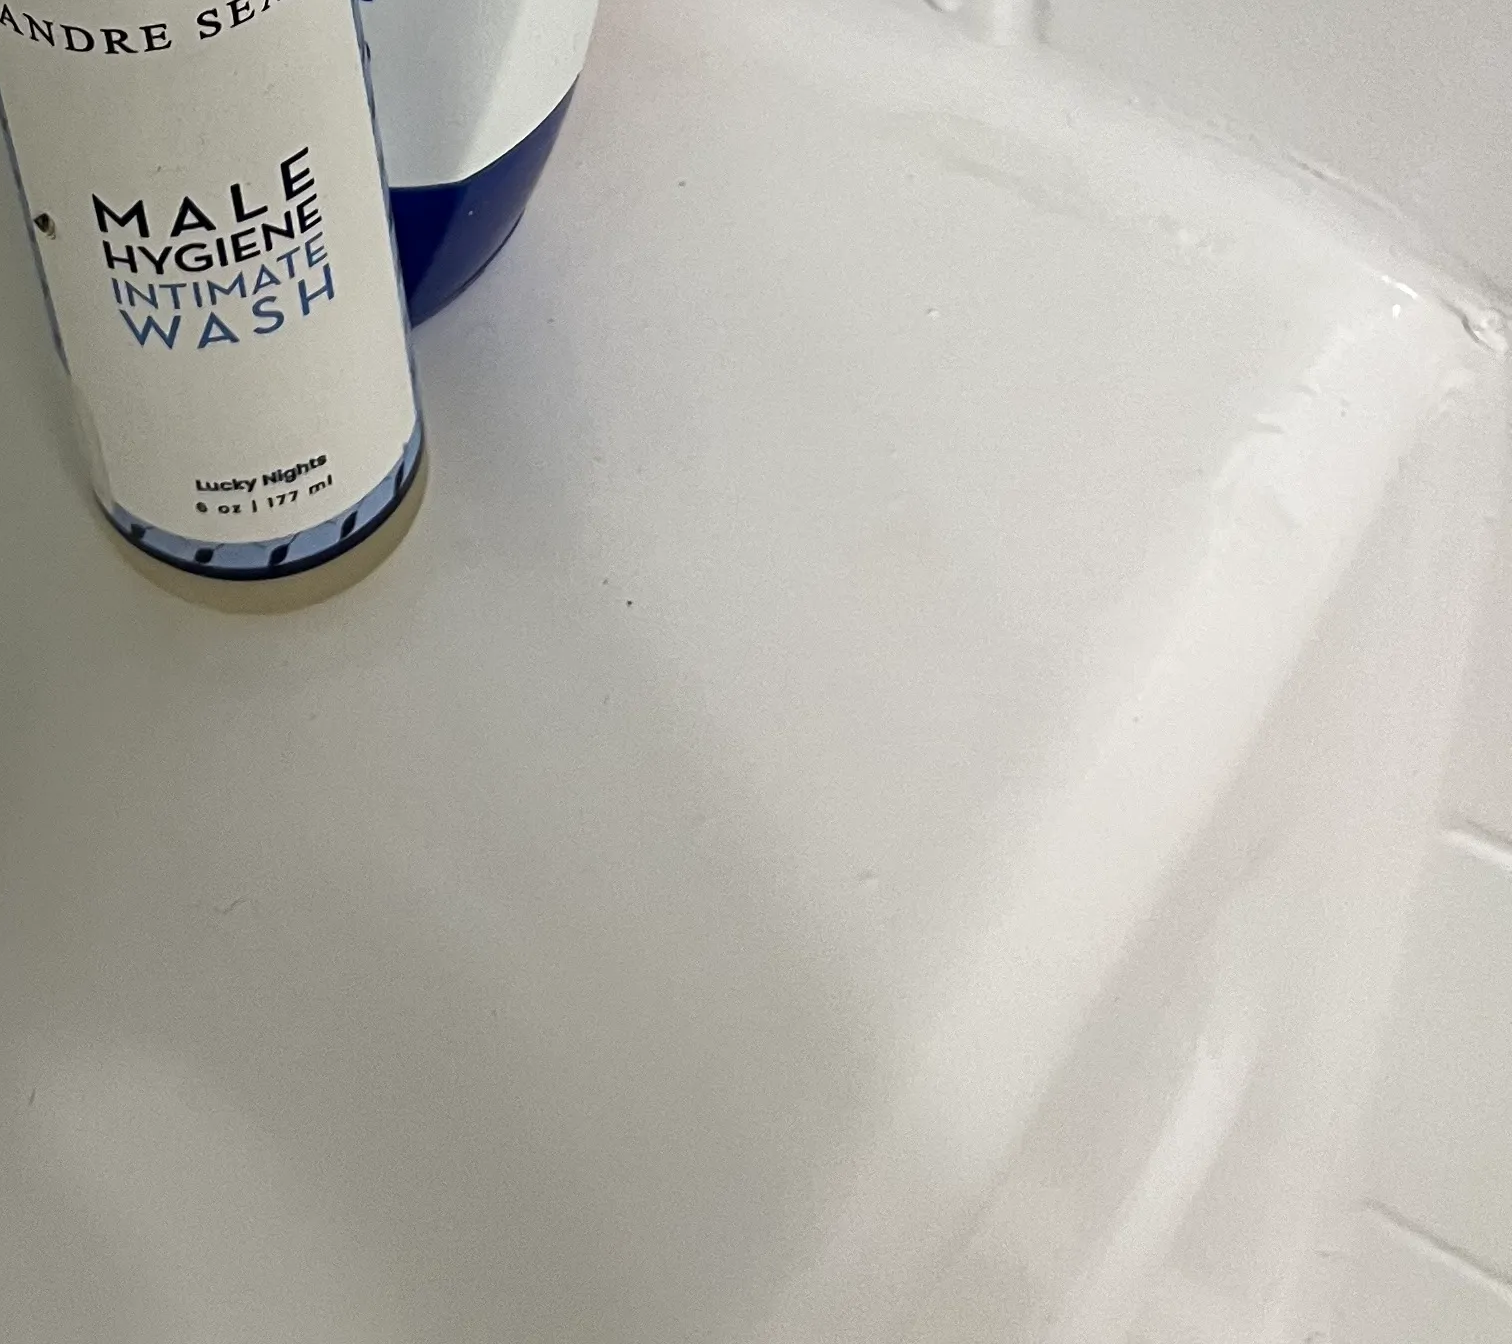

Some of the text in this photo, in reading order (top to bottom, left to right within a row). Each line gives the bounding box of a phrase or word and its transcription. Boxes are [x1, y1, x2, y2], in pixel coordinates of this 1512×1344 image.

[0, 3, 172, 55] ANDRE
[92, 146, 315, 238] MALE
[102, 193, 323, 275] HYGIENE
[111, 231, 328, 310] INTIMATE
[118, 263, 335, 349] WASH
[195, 454, 327, 492] Lucky Nights
[218, 504, 241, 514] oz
[267, 490, 298, 508] 177
